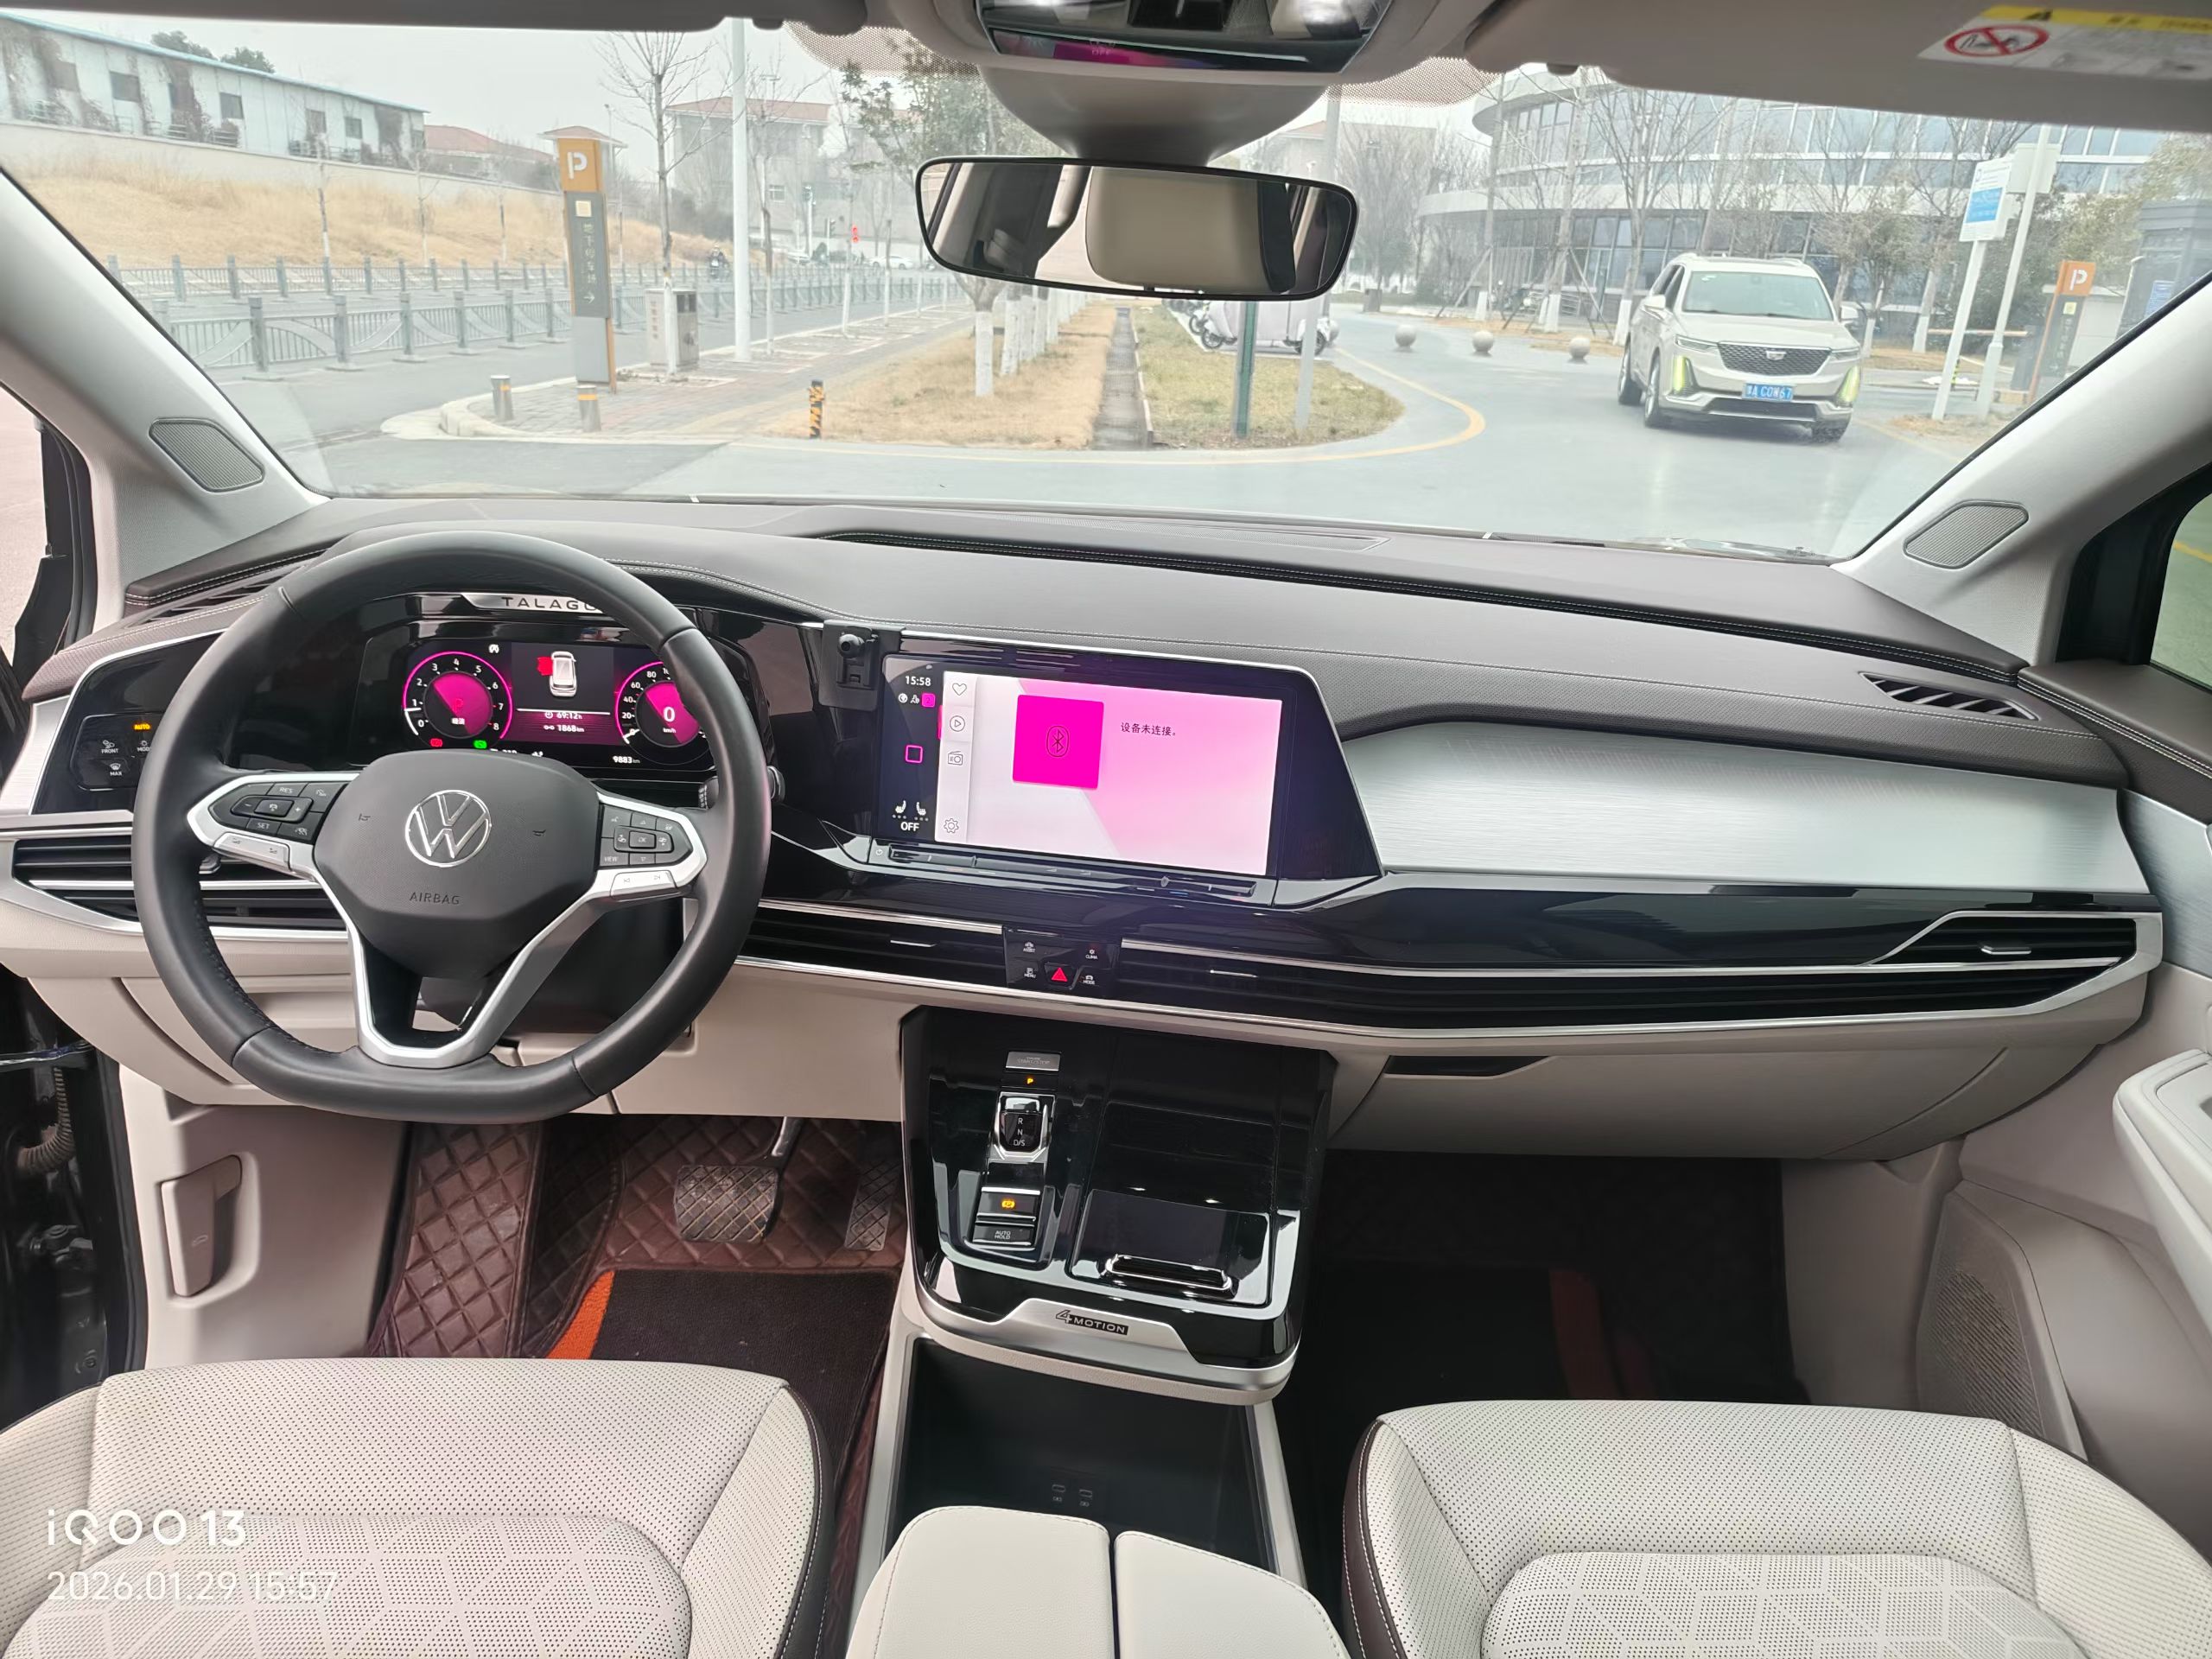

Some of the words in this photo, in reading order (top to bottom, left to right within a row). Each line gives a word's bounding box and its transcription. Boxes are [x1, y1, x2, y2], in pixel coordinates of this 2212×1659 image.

[567, 151, 588, 180] P
[2069, 269, 2088, 291] P
[432, 663, 438, 671] 3
[475, 664, 482, 673] 5
[905, 676, 931, 687] 15:58
[663, 706, 676, 722] 0
[1121, 721, 1176, 736] 设备未连接。
[900, 822, 920, 831] OFF
[410, 892, 461, 905] AIRBAG
[1055, 1309, 1126, 1334] 4MOTION
